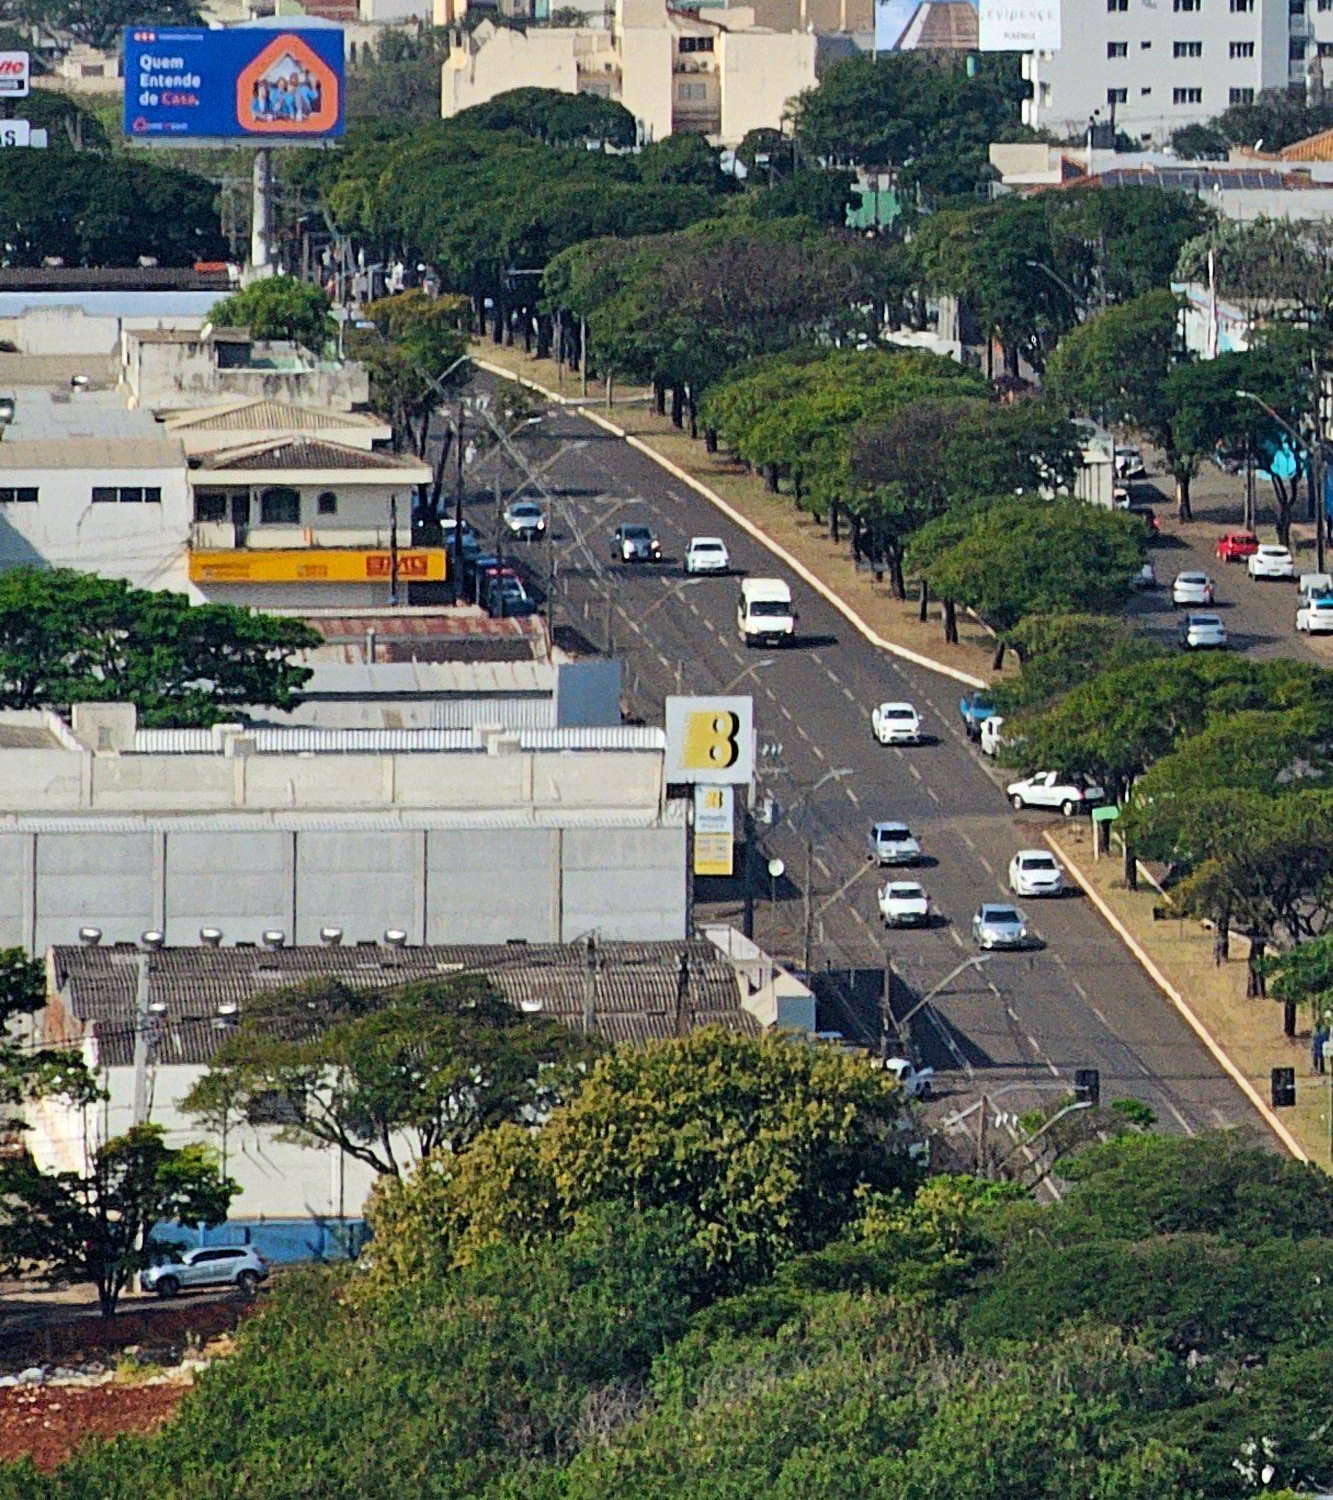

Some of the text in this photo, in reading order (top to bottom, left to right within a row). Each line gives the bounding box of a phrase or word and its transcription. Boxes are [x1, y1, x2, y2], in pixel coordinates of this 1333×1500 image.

[139, 54, 184, 70] Quem
[139, 73, 201, 88] Entende
[138, 91, 159, 106] de
